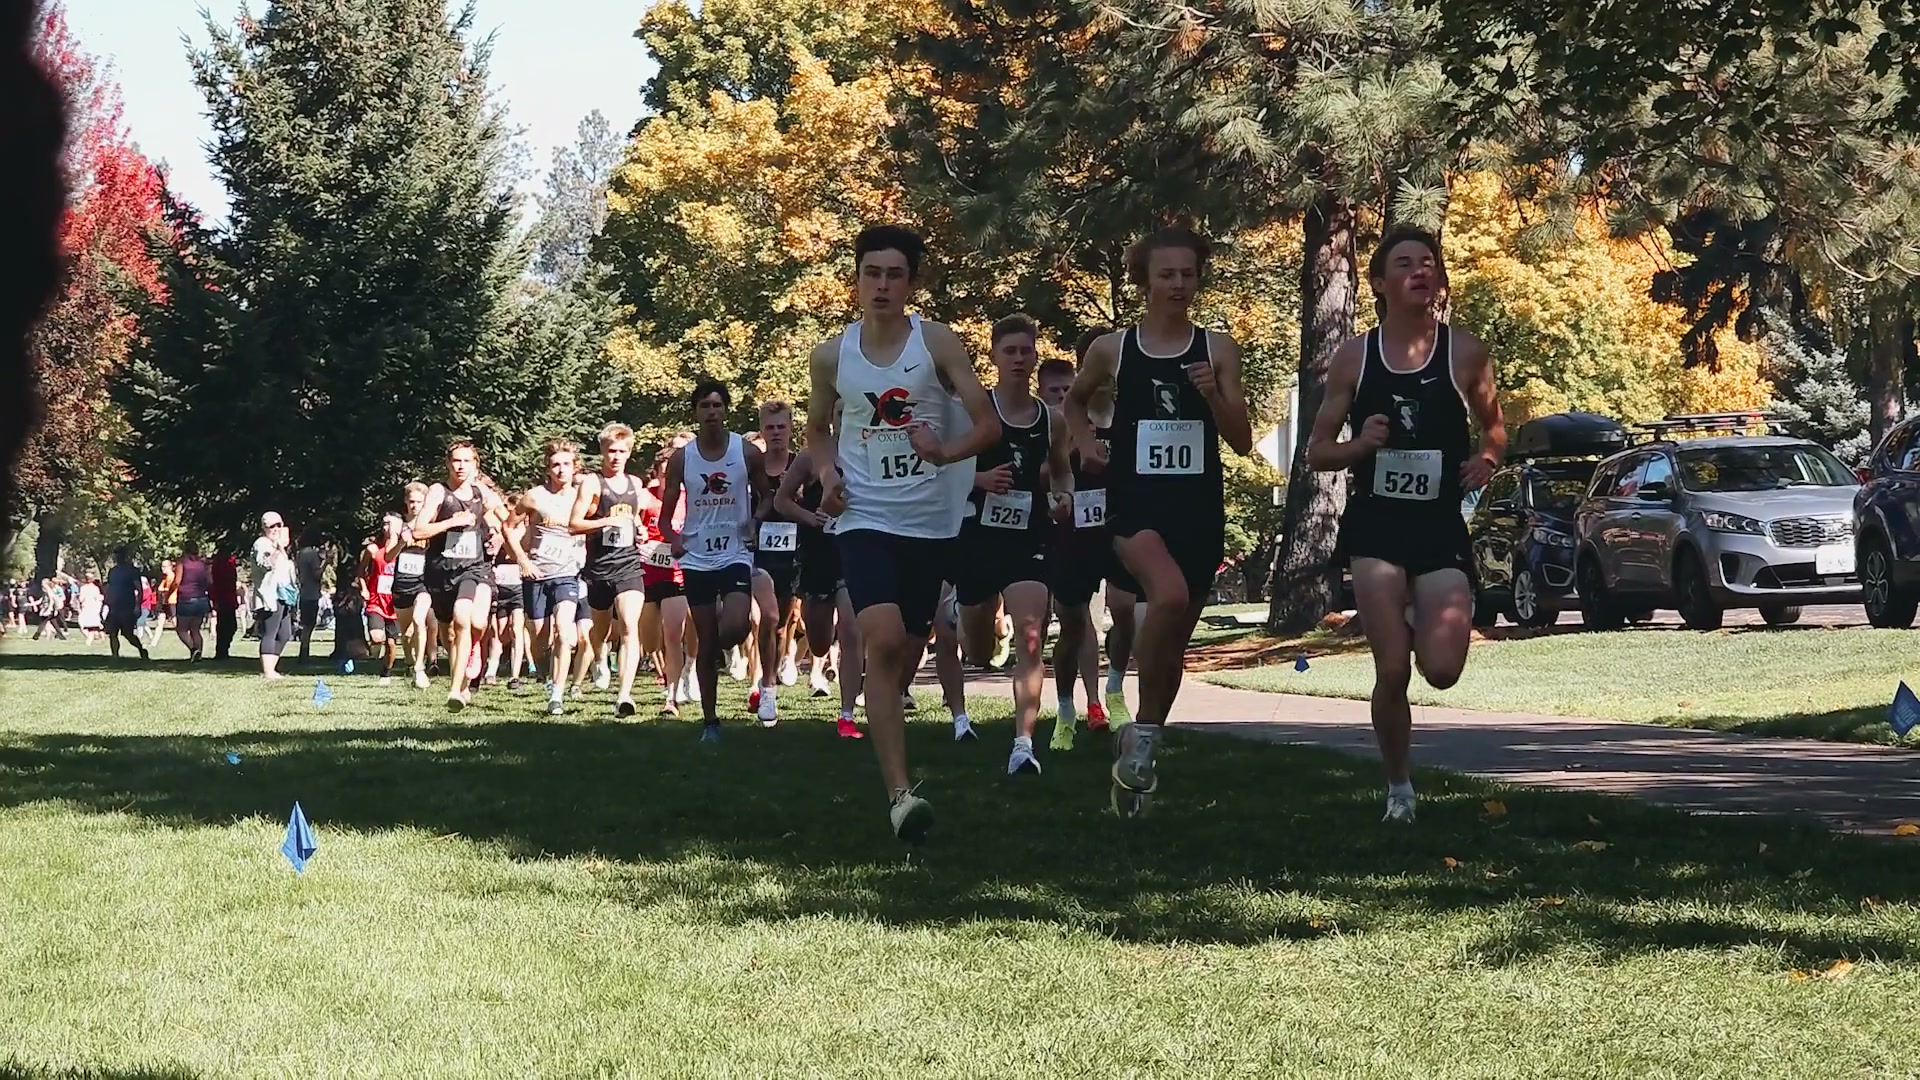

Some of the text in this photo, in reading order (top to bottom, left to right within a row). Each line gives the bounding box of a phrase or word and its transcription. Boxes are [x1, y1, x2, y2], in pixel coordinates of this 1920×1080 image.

[1149, 422, 1192, 432] OXFORD
[878, 431, 912, 442] OXFO
[1149, 444, 1192, 469] 510
[880, 453, 925, 479] 152
[1384, 470, 1429, 496] 528
[694, 498, 736, 507] CALDERA
[990, 505, 1023, 525] 525
[1083, 506, 1102, 523] 19
[705, 536, 730, 552] 147
[765, 535, 789, 548] 424
[650, 553, 671, 566] 405
